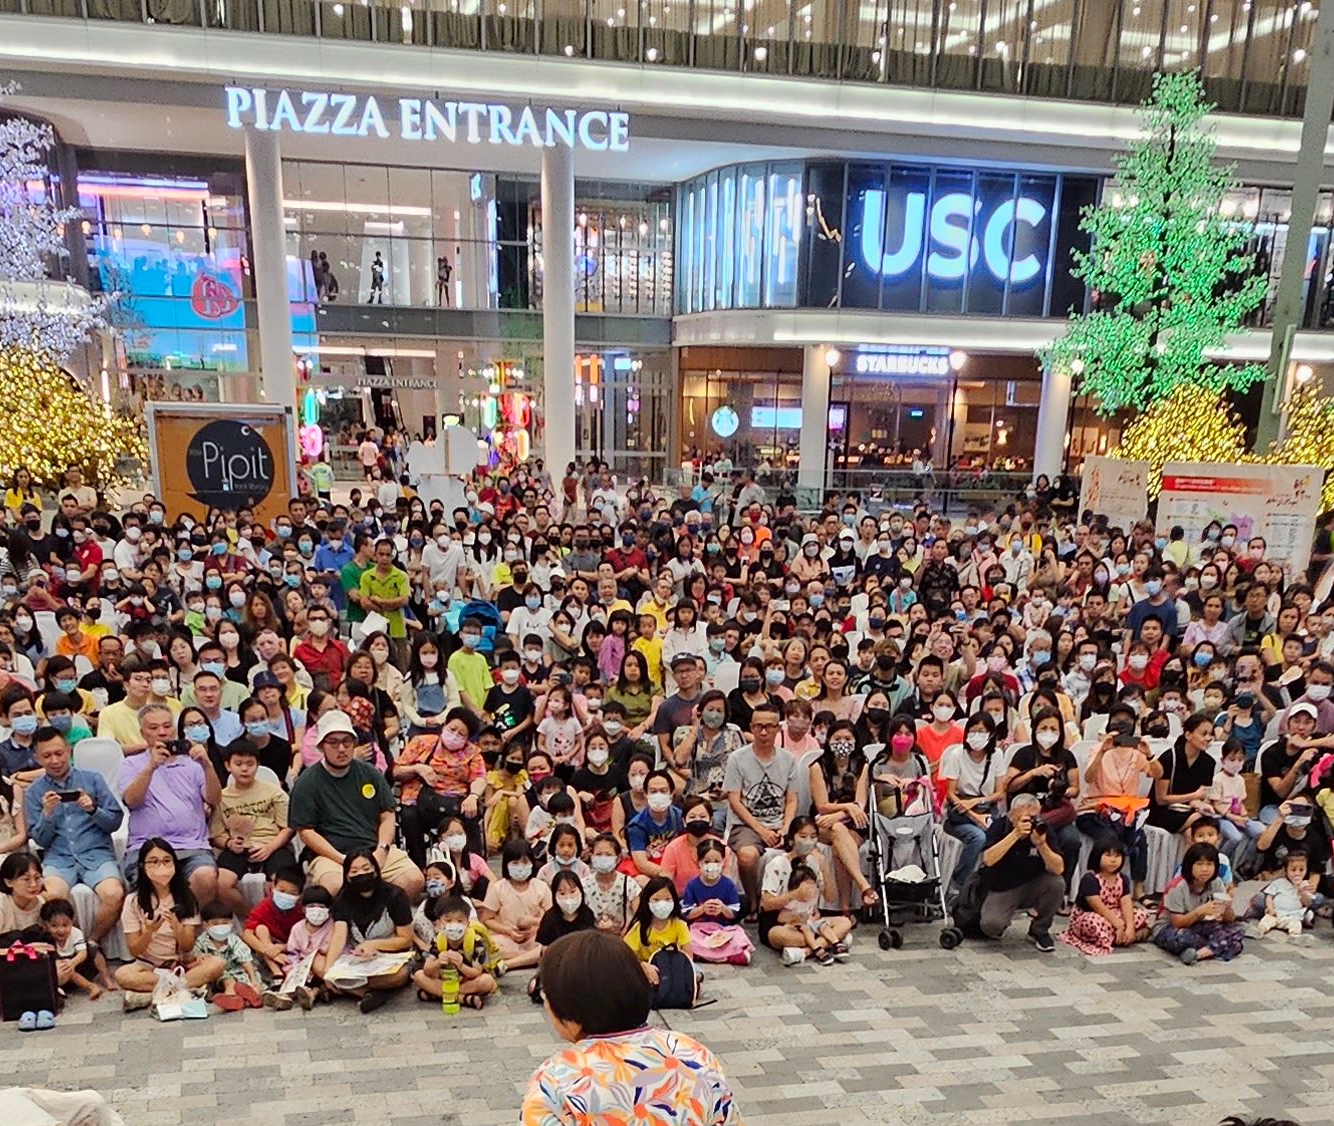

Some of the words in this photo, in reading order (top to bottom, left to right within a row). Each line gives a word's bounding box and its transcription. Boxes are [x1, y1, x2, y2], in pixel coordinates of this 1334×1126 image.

[225, 86, 390, 138] PIAZZA
[398, 98, 629, 152] ENTRANCE
[862, 190, 1046, 283] USC
[856, 354, 950, 375] STARBUCKS
[203, 441, 269, 491] Pipit
